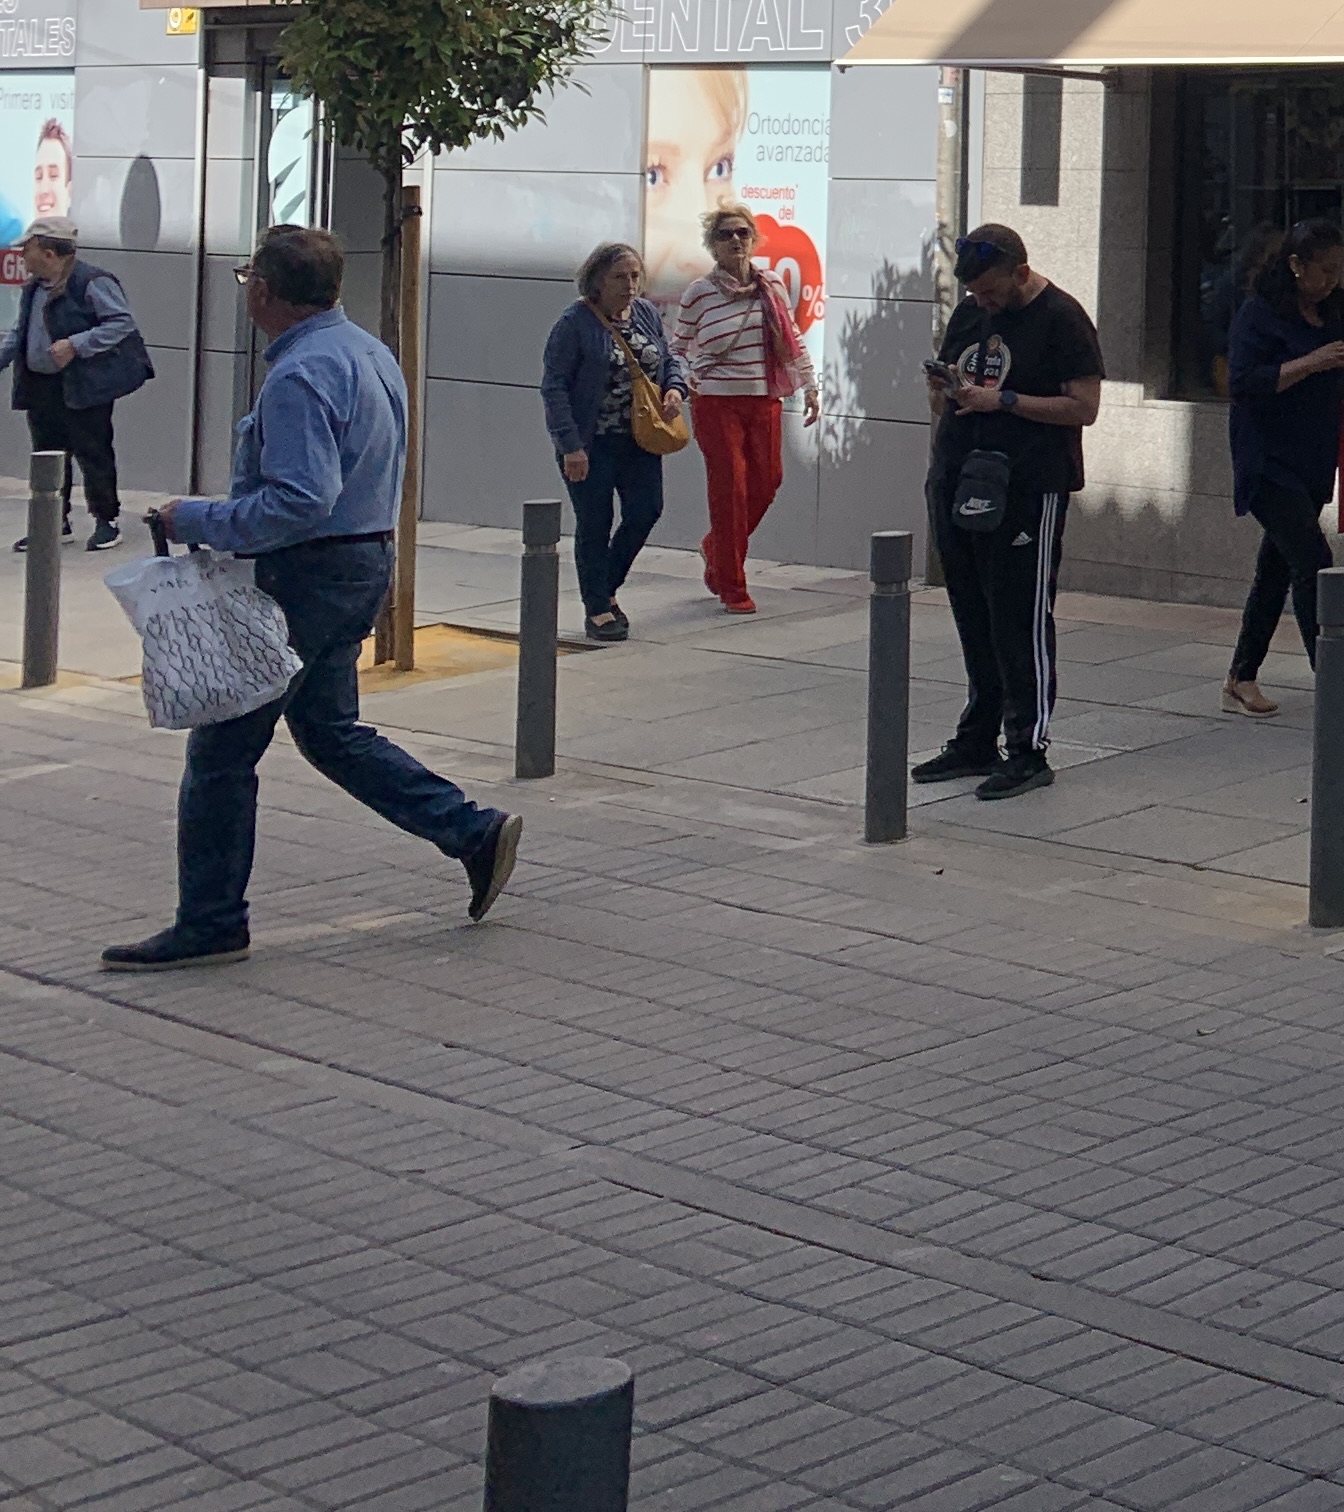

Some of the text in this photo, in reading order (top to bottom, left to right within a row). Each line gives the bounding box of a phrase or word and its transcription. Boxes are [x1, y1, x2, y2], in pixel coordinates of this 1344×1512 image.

[747, 112, 831, 135] Ortodoncia
[756, 144, 830, 163] avanzada
[778, 204, 795, 221] del
